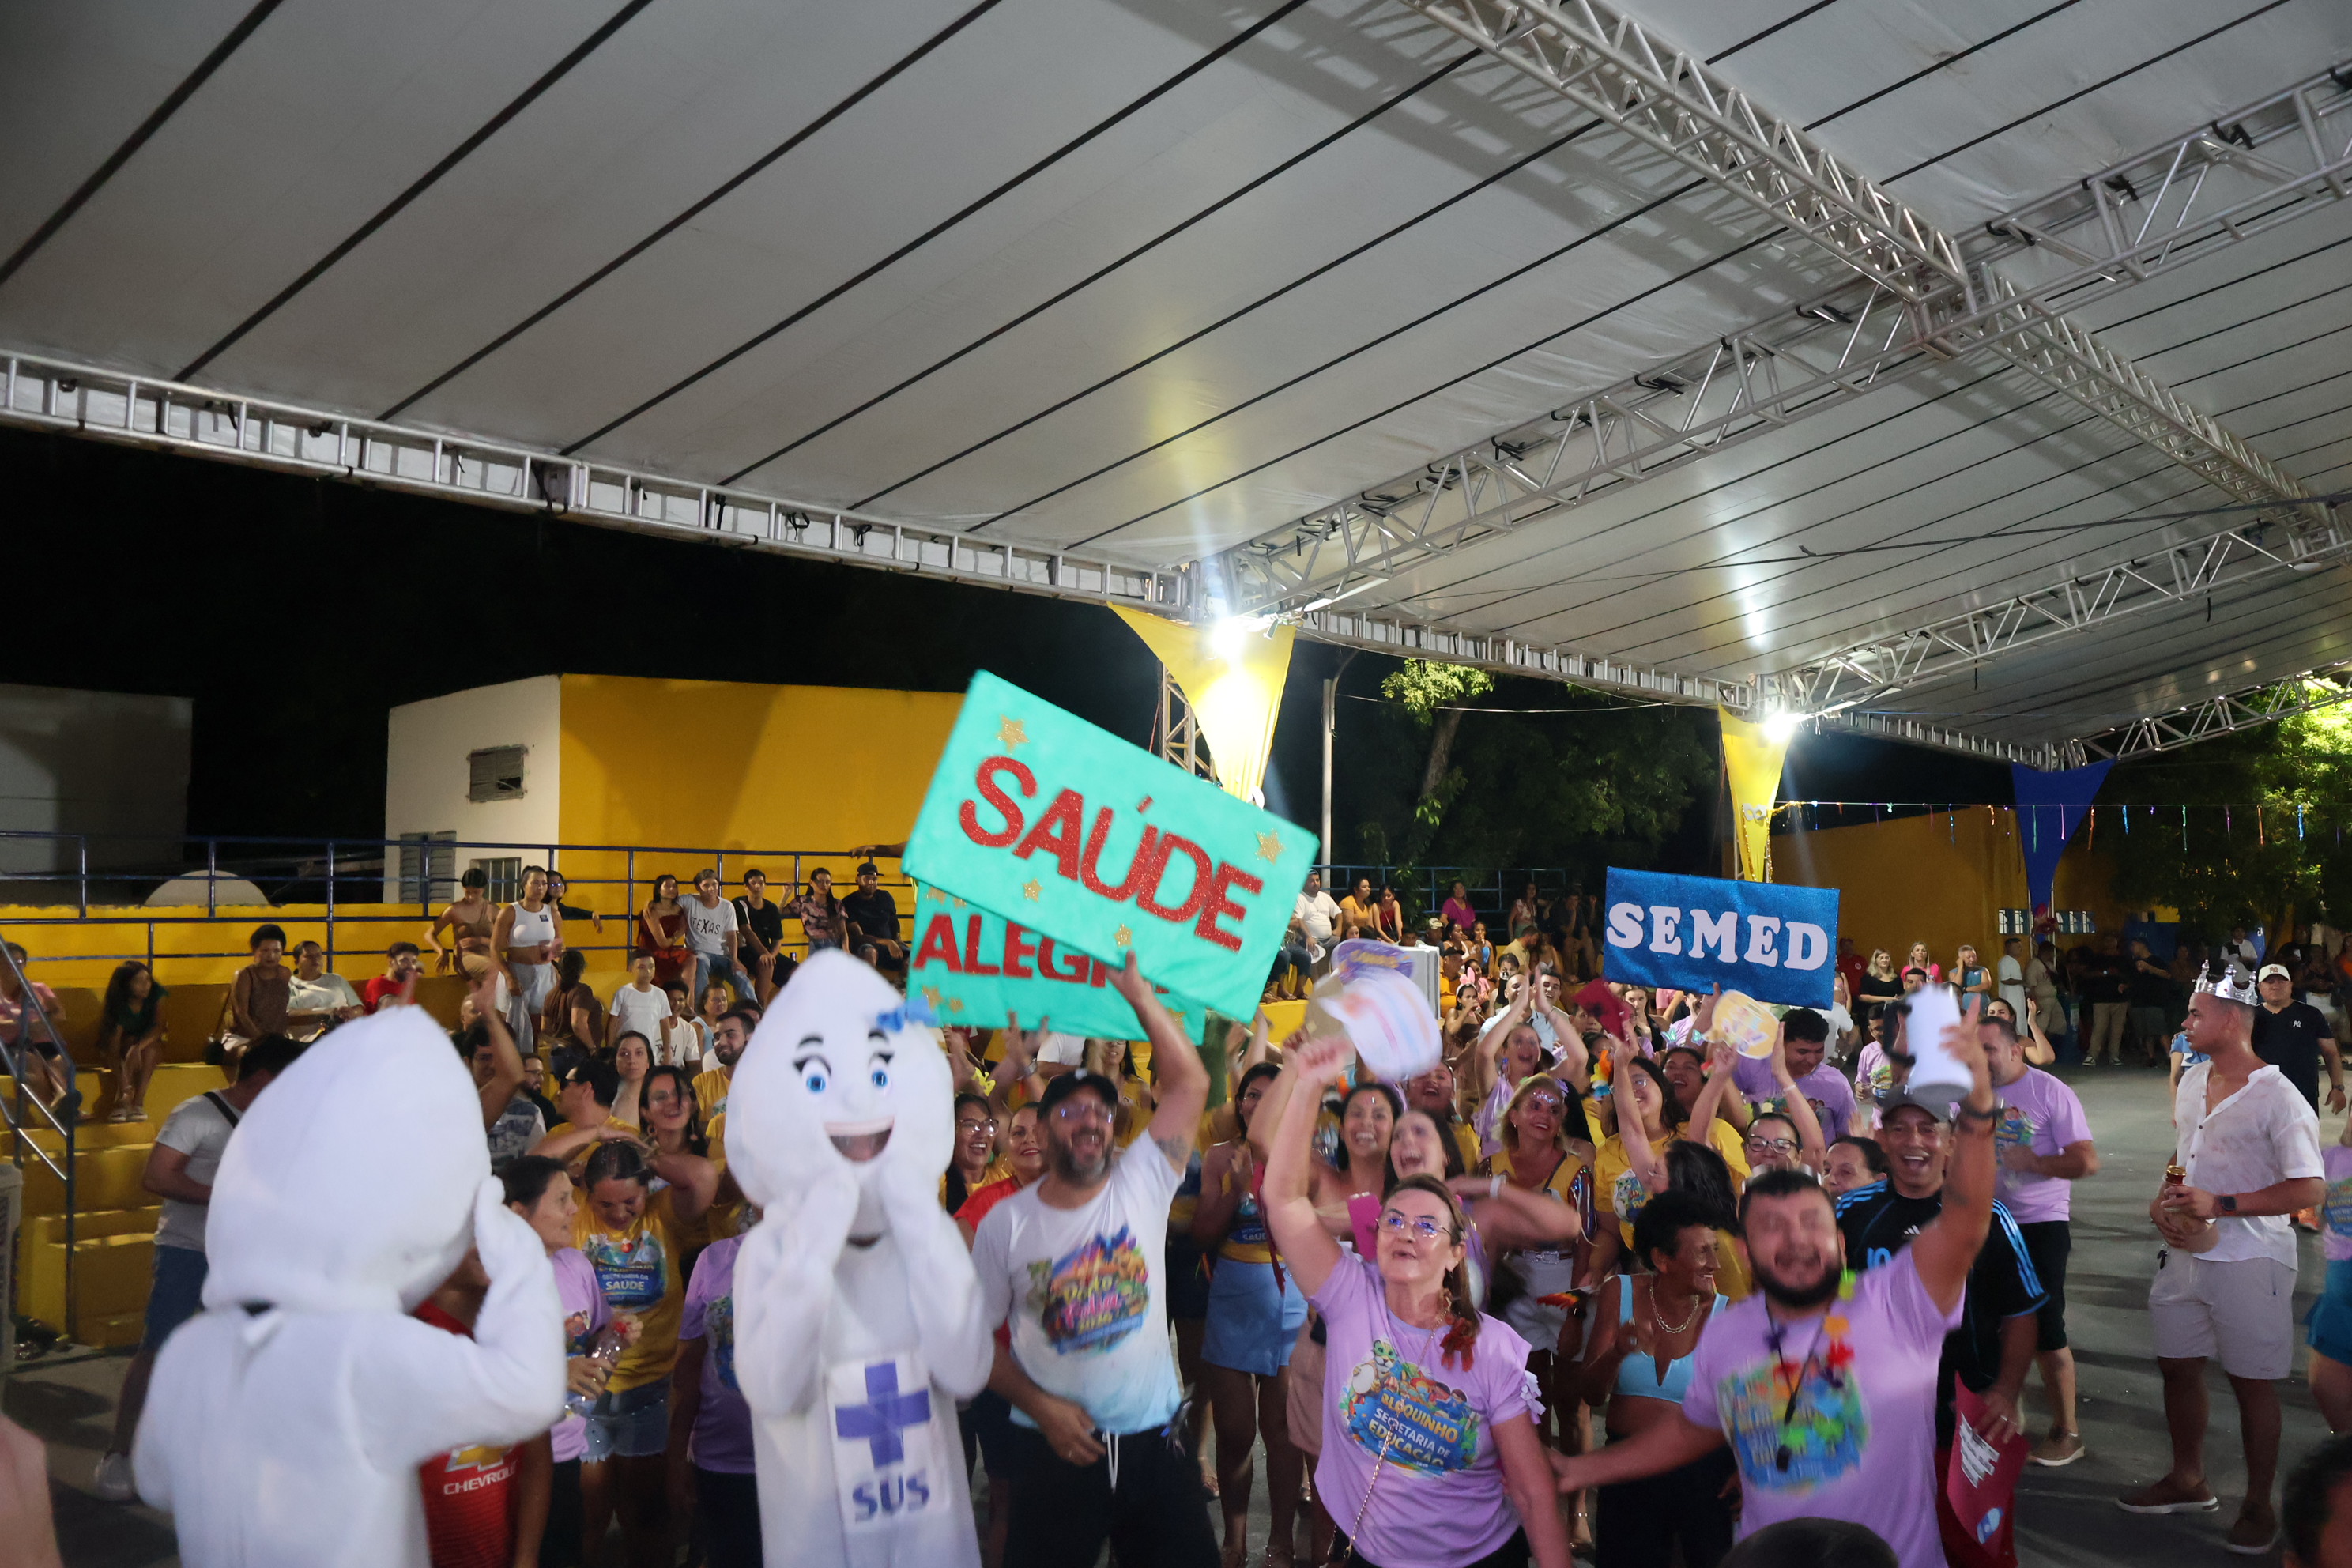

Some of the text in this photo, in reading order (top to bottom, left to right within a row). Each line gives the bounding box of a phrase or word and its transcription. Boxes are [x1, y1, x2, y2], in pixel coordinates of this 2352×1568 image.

[959, 755, 1264, 953] SAÚDE
[692, 917, 721, 935] TEXAS
[1606, 902, 1829, 971] SEMED
[1374, 1408, 1434, 1451] SECRETARIA
[1437, 1445, 1451, 1458] DE
[1381, 1393, 1458, 1443] BLOQUINHO
[852, 1468, 930, 1524] SUS
